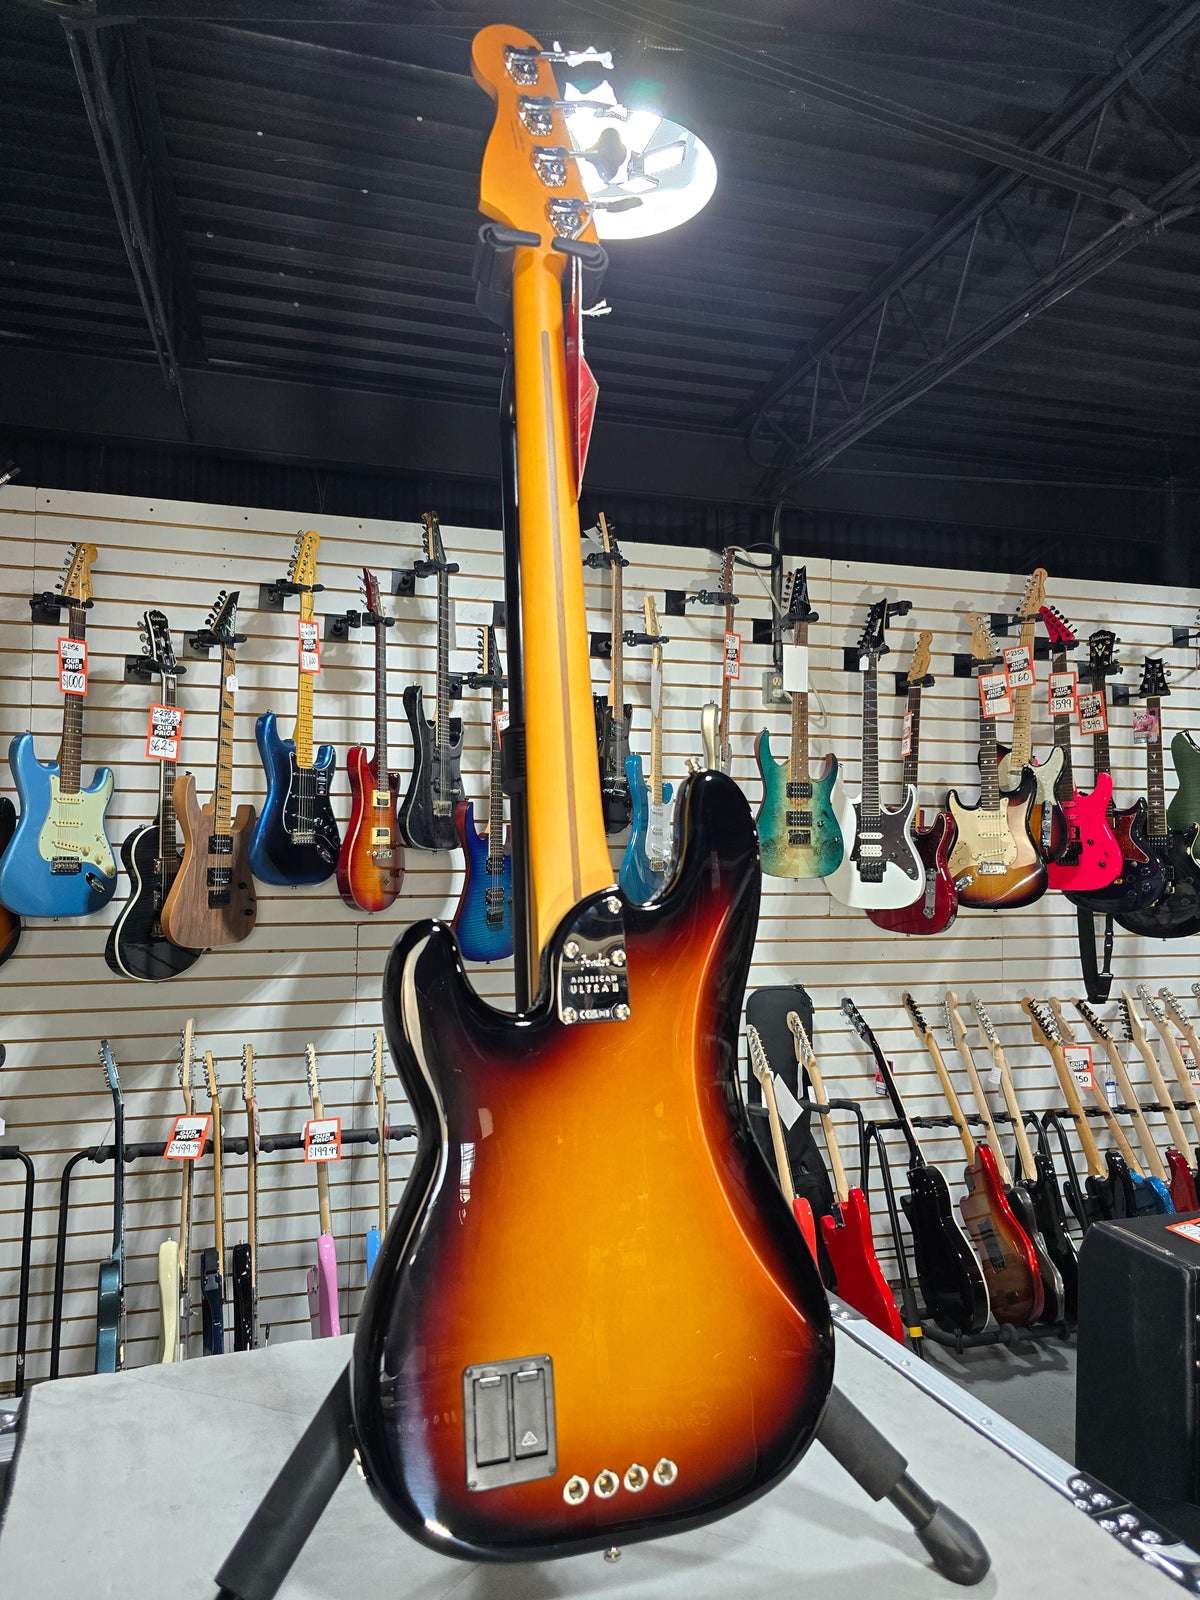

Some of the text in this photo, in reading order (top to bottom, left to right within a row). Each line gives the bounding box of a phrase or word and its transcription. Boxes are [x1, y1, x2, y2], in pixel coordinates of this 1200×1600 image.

[1010, 662, 1028, 672] PRICE
[1012, 659, 1025, 667] OUR
[62, 674, 84, 689] $1000
[1009, 672, 1029, 684] $160
[987, 690, 1005, 699] PRICE
[1051, 699, 1072, 711] $599
[1083, 710, 1100, 718] PRICE
[1082, 720, 1102, 730] $349
[150, 739, 175, 753] $625
[570, 975, 618, 983] AMERICAN
[570, 984, 610, 994] ULTRA
[311, 1136, 335, 1144] PRICE
